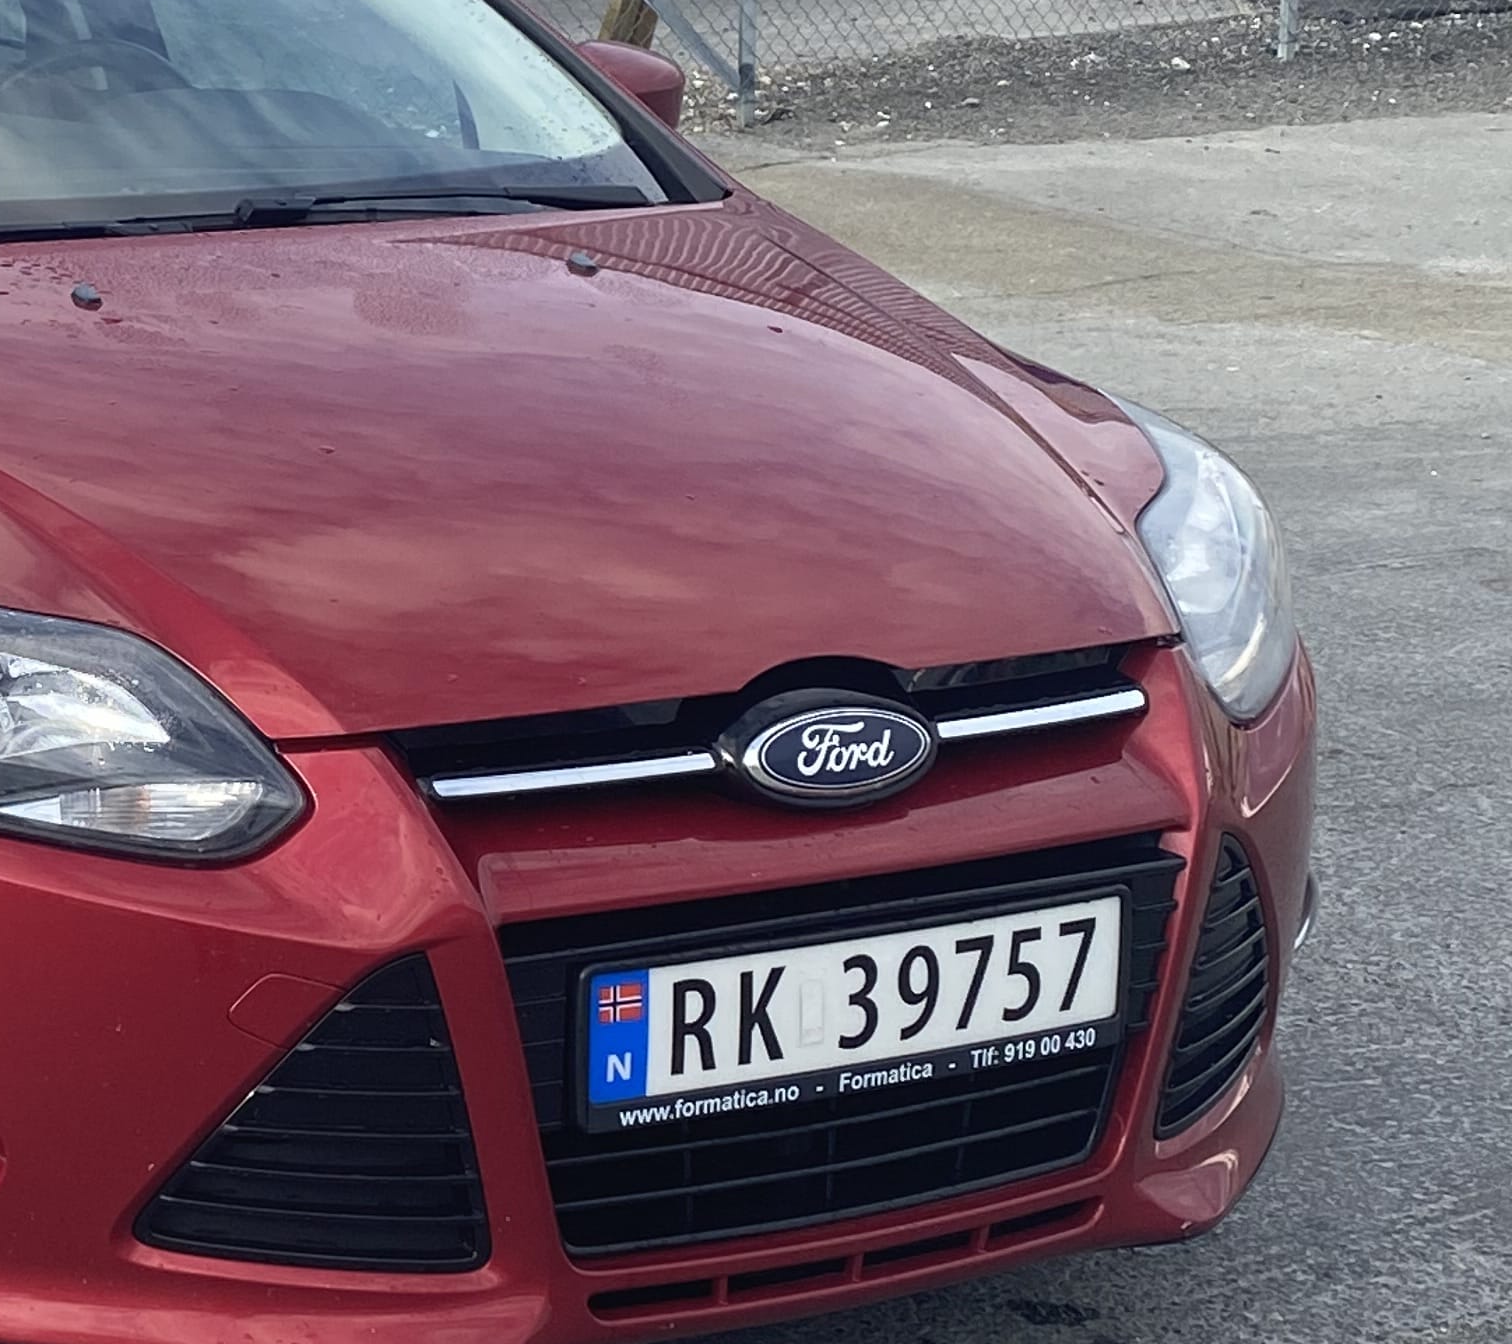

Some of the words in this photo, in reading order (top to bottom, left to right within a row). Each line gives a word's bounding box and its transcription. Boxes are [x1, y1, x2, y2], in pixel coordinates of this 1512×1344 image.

[797, 722, 895, 776] Ford
[671, 966, 786, 1076] RK
[838, 917, 1096, 1049] 39757
[606, 1052, 632, 1082] N
[619, 1085, 800, 1126] www.formatica.no
[839, 1062, 933, 1092] Formatica
[1004, 1042, 1035, 1063] 919
[1040, 1034, 1061, 1056] 00
[1064, 1027, 1096, 1050] 430
